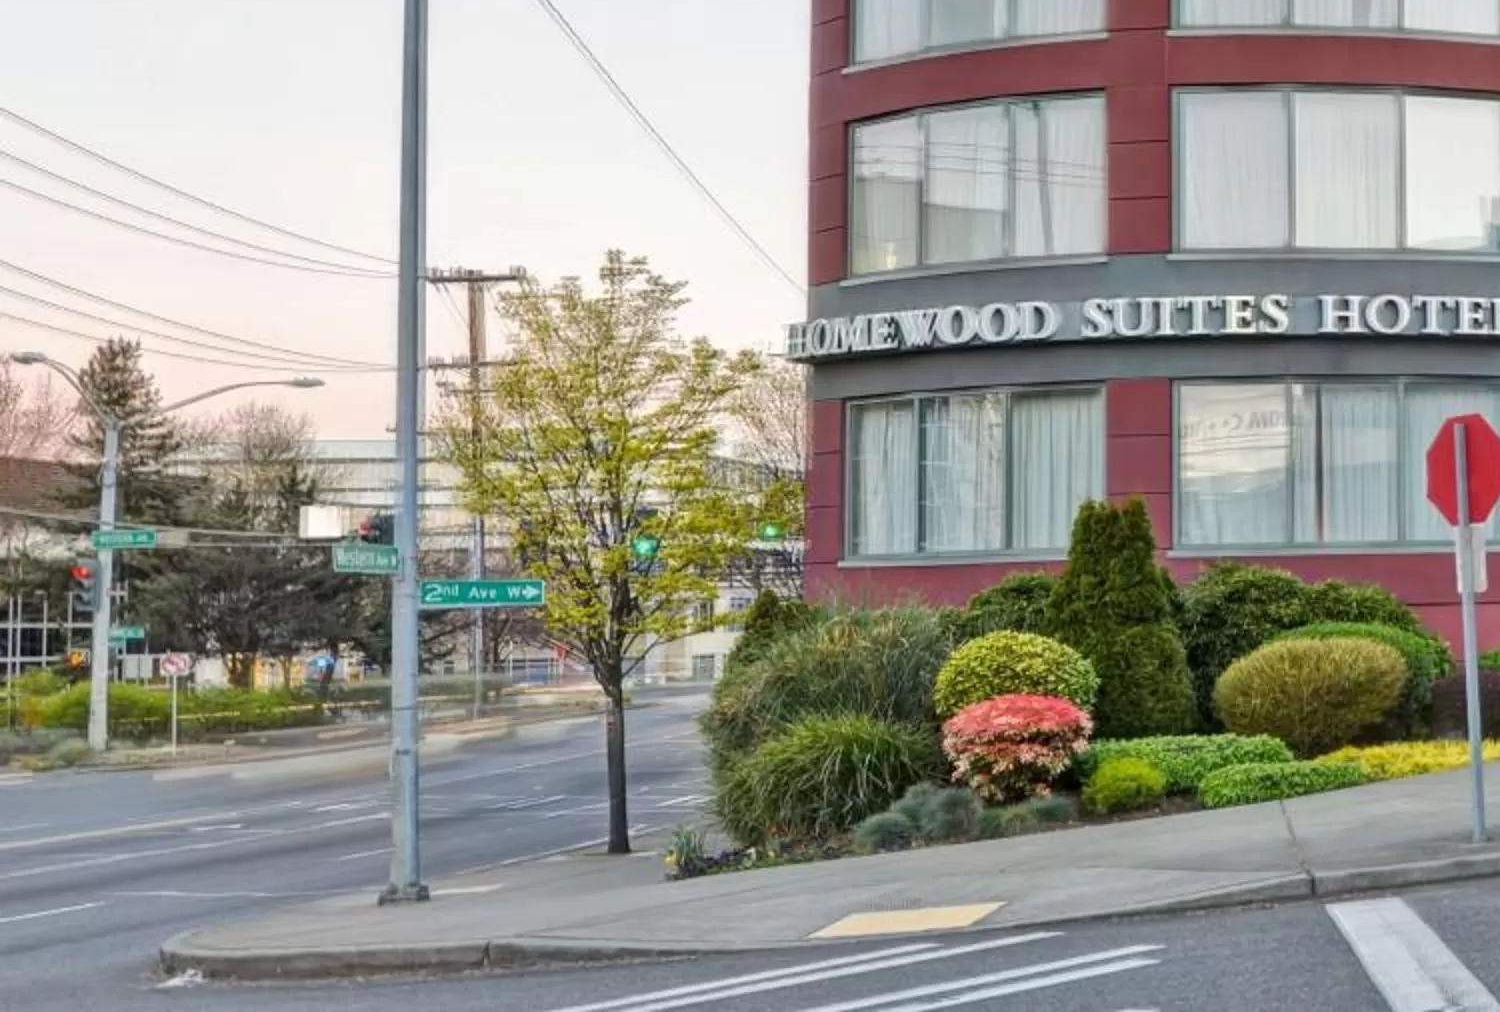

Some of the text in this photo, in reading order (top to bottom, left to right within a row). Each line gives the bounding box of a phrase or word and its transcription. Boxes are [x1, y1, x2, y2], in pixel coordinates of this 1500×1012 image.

[787, 301, 1060, 357] HOMEWOOD
[1080, 294, 1290, 338] SUITES
[424, 583, 522, 602] 2nd Ave W
